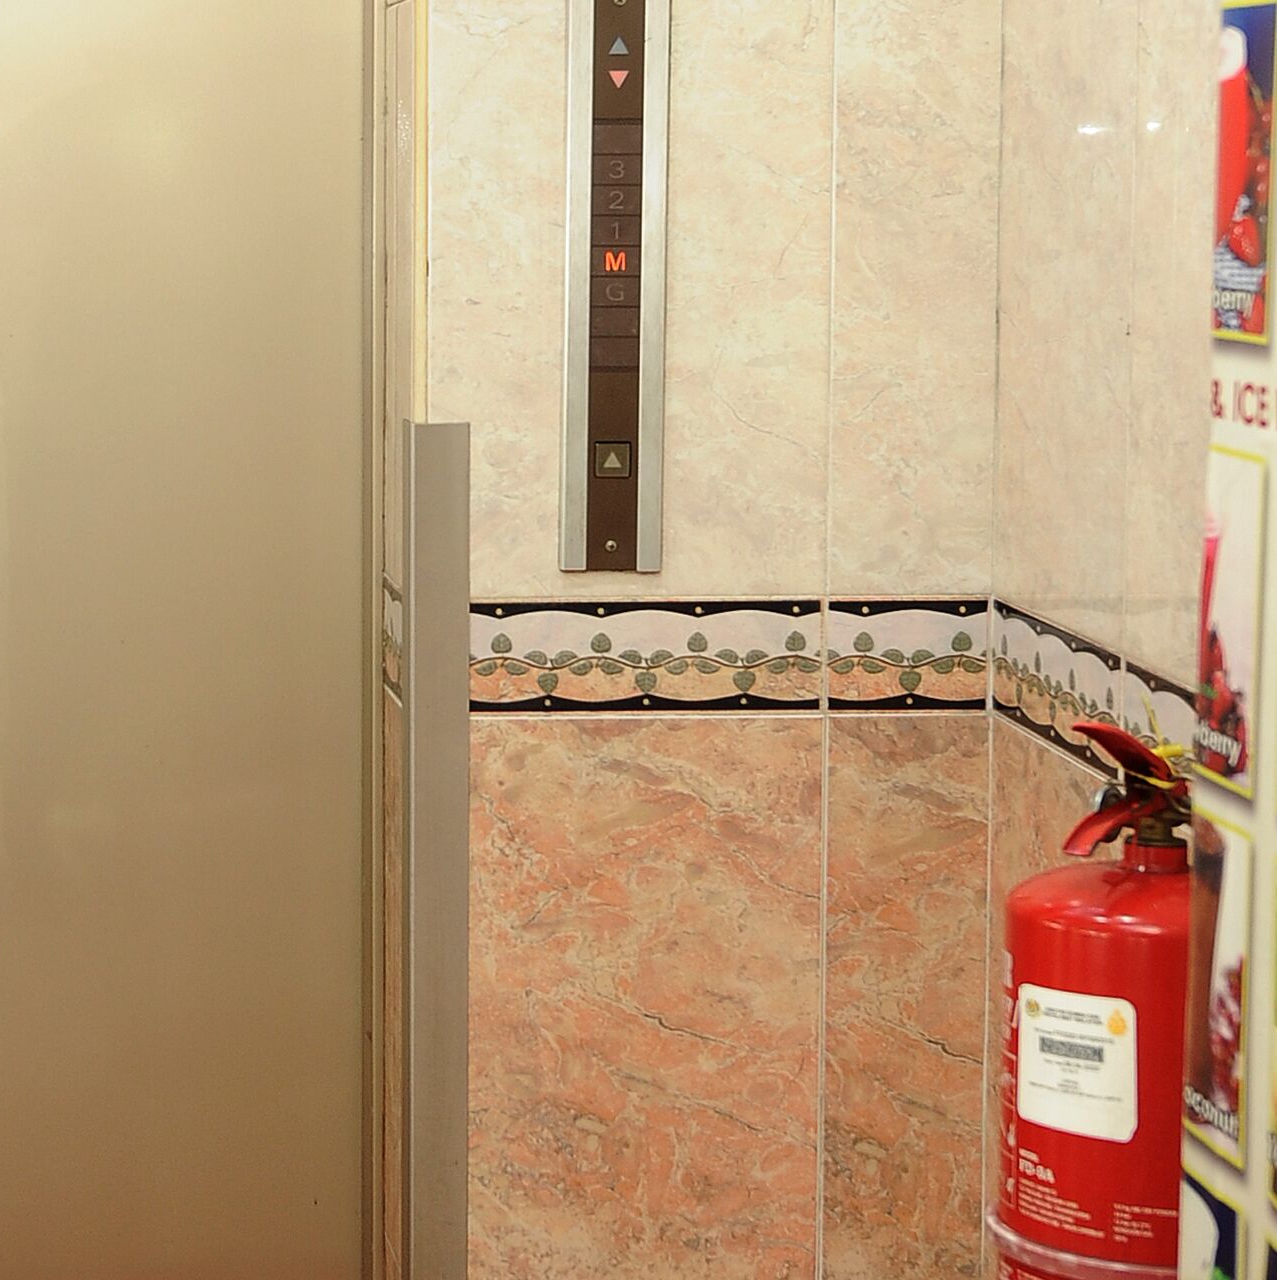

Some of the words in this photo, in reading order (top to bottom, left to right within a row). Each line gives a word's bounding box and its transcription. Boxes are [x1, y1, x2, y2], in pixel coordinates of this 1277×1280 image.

[609, 160, 624, 179] 3
[609, 191, 624, 209] 2
[612, 222, 619, 240] 1
[605, 251, 626, 272] M
[606, 283, 624, 301] G
[1232, 382, 1269, 428] ICE
